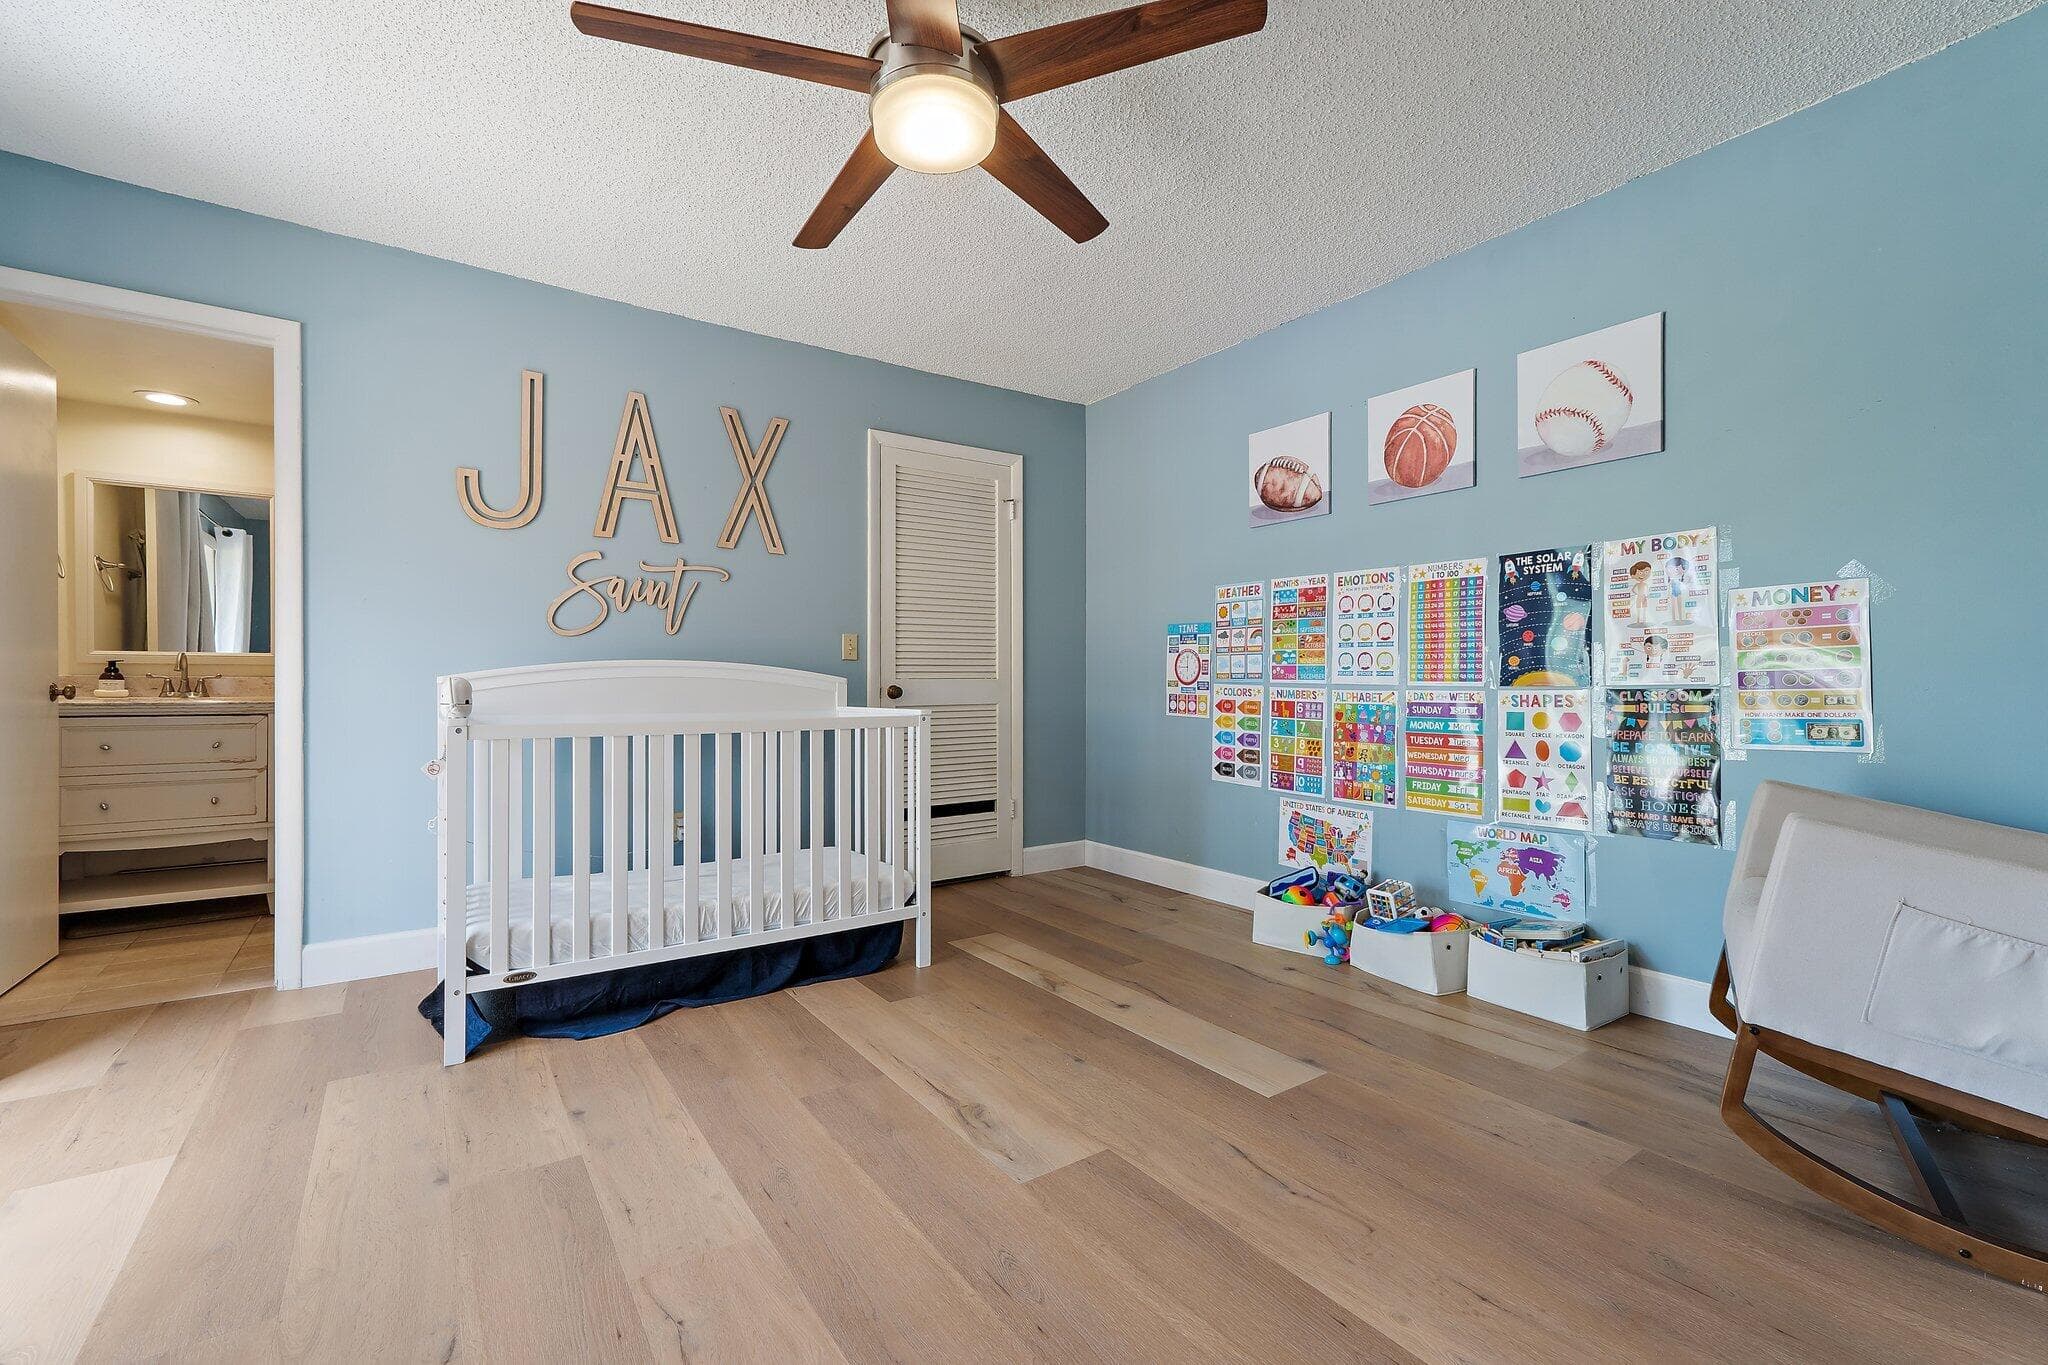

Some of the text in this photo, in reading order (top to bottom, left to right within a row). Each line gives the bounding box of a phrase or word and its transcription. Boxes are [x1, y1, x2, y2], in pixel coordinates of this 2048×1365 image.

[455, 367, 790, 556] JAX
[1620, 534, 1698, 556] MY BODY
[1516, 552, 1572, 566] THE SOLAR
[1428, 562, 1463, 572] NUMBERS
[1523, 563, 1563, 575] SYSTEM
[1274, 579, 1299, 588] MONTHS
[1308, 577, 1326, 585] YEAR
[1337, 572, 1395, 586] EMOTIONS
[547, 550, 730, 637] Saint
[1219, 585, 1260, 598] WEATHER
[1752, 584, 1840, 607] MONEY
[1178, 624, 1198, 633] TIME
[1223, 688, 1252, 697] COLORS
[1276, 690, 1317, 700] NUMBERS
[1335, 692, 1382, 702] ALPHABET
[1414, 692, 1434, 700] DAYS
[1449, 693, 1475, 702] WEEK
[1619, 690, 1702, 702] CLASSROOM
[1511, 694, 1574, 708] SHAPES
[1274, 702, 1278, 712] 1
[1297, 703, 1304, 713] 6
[1412, 706, 1442, 714] SUNDAY
[1639, 703, 1681, 714] RULES
[1272, 720, 1278, 730] 2
[1300, 722, 1305, 732] 7
[1410, 721, 1444, 730] MONDAY
[1410, 736, 1444, 745] TUESDAY
[1612, 730, 1714, 742] PREPARE TO LEARN
[1274, 738, 1280, 748] 3
[1299, 740, 1305, 750] 8
[1612, 742, 1630, 753] BE
[1272, 756, 1278, 766] 4
[1408, 752, 1447, 761] WEDNESDAY
[1612, 754, 1644, 764] ALWAYS
[1688, 757, 1711, 767] BEST
[1297, 758, 1304, 768] 9
[1408, 765, 1447, 776] THURSDAY
[1613, 764, 1648, 774] BELIEVE
[1665, 766, 1712, 778] YOURSELF
[1272, 773, 1278, 783] 5
[1614, 774, 1630, 784] BE
[1412, 781, 1441, 792] FRIDAY
[1613, 786, 1713, 802] ASK QUESTIONS
[1408, 795, 1447, 808] SATURDAY
[1614, 798, 1710, 816] BE HONEST
[1282, 800, 1304, 810] UNITED
[1305, 804, 1325, 813] STATES
[1338, 809, 1369, 820] AMERICA
[1501, 812, 1531, 820] RECTANGLE
[1556, 817, 1588, 825] TRAPOID
[1613, 810, 1636, 818] WORK
[1638, 812, 1660, 821] HARD
[1671, 815, 1694, 824] HAVE
[1696, 817, 1715, 826] FUN
[1613, 818, 1715, 836] ALWAYS BE KIND
[1478, 827, 1548, 844] WORLD MAP
[1498, 866, 1521, 875] AFRICA
